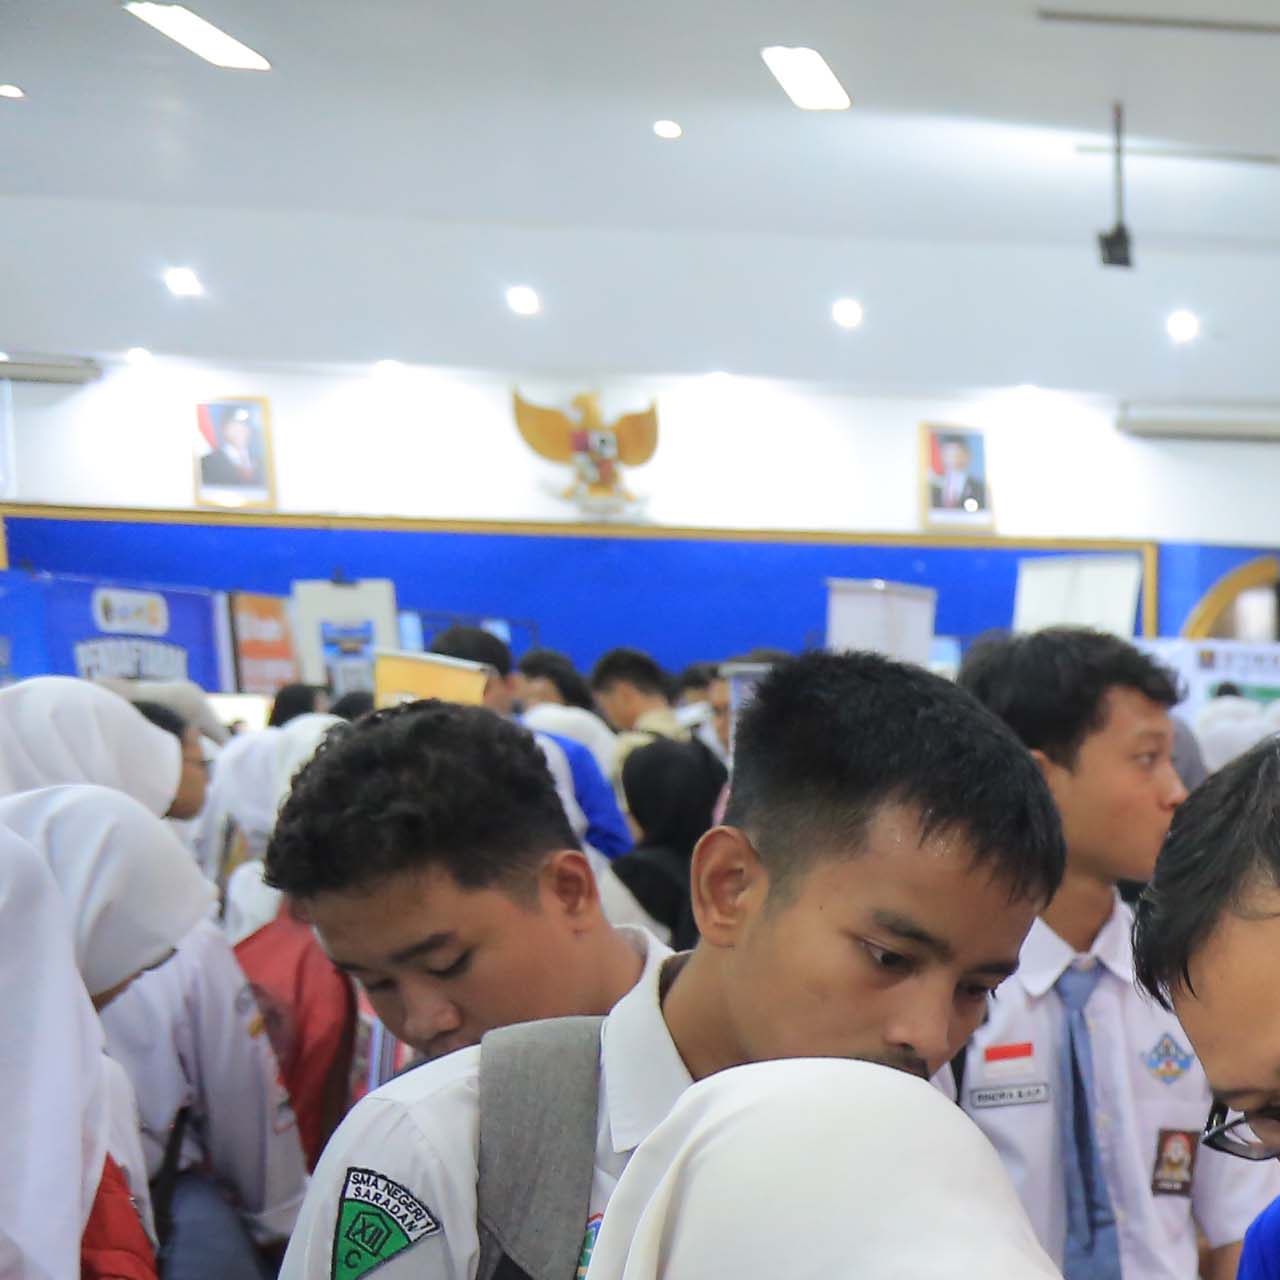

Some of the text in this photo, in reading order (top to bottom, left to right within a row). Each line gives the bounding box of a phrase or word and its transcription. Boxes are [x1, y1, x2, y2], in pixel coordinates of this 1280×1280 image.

[350, 1173, 379, 1190] SMA
[383, 1182, 426, 1221] NEGERI
[353, 1186, 418, 1232] SARADAN
[351, 1216, 385, 1249] XII
[345, 1249, 362, 1270] C
